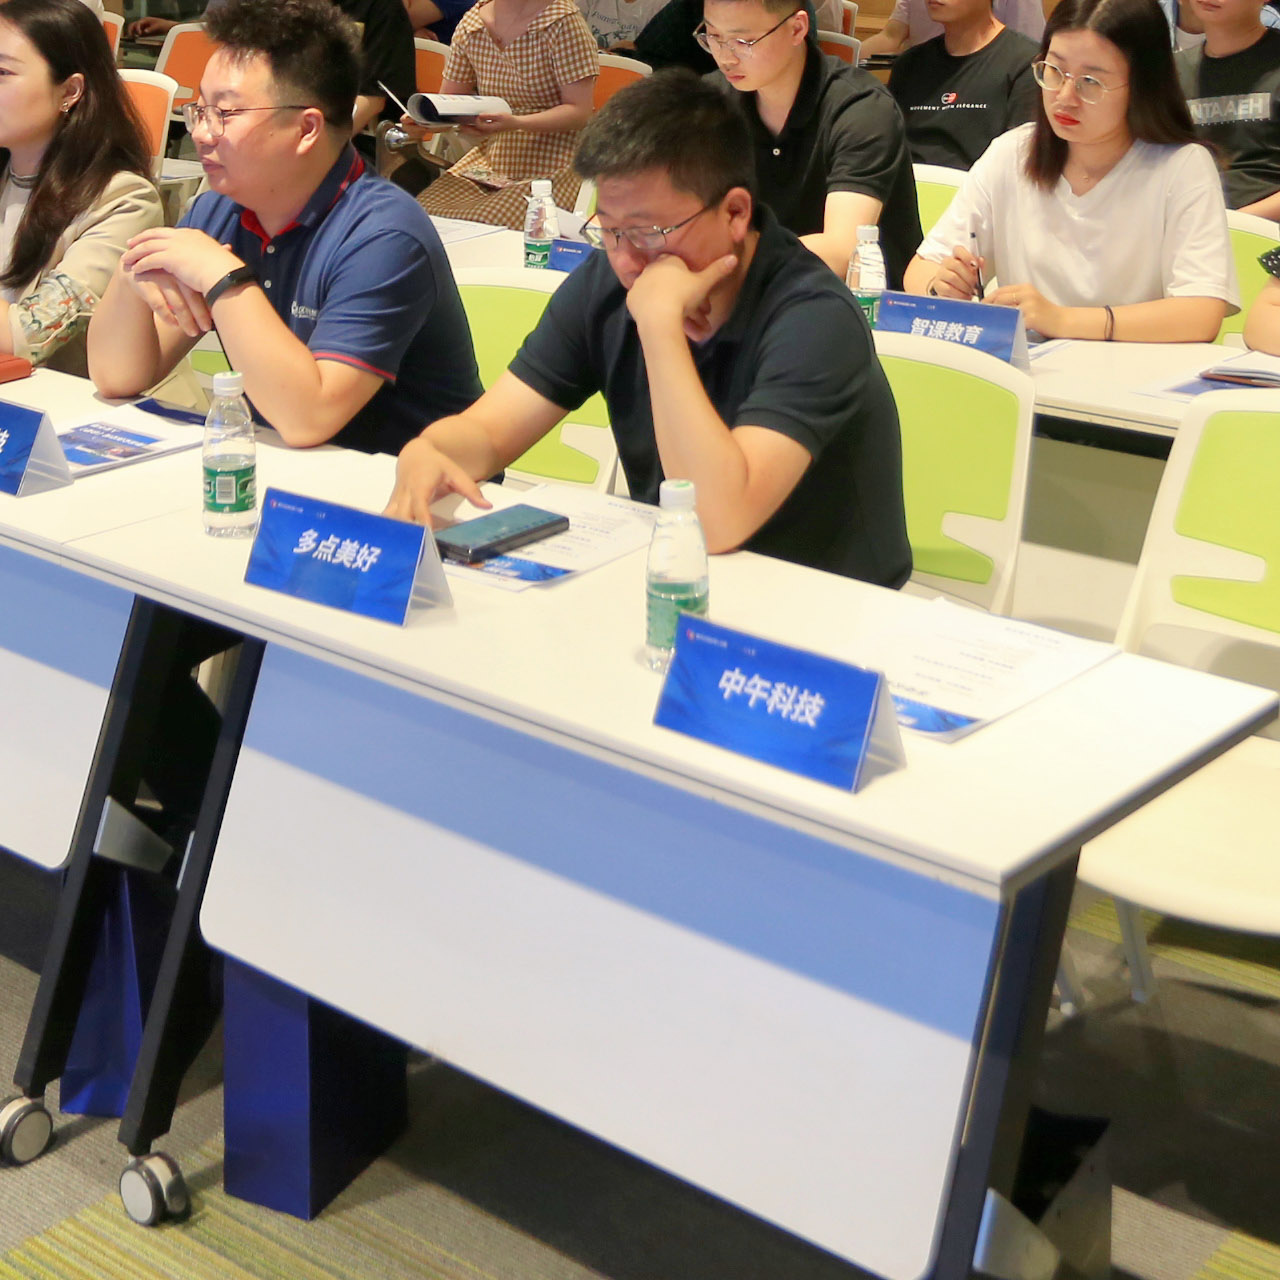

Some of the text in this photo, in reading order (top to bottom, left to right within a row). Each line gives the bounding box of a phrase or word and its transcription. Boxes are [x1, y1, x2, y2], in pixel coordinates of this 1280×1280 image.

[910, 317, 984, 345] 智课教育
[293, 528, 382, 572] 多点美好
[718, 667, 826, 728] 中午科技
